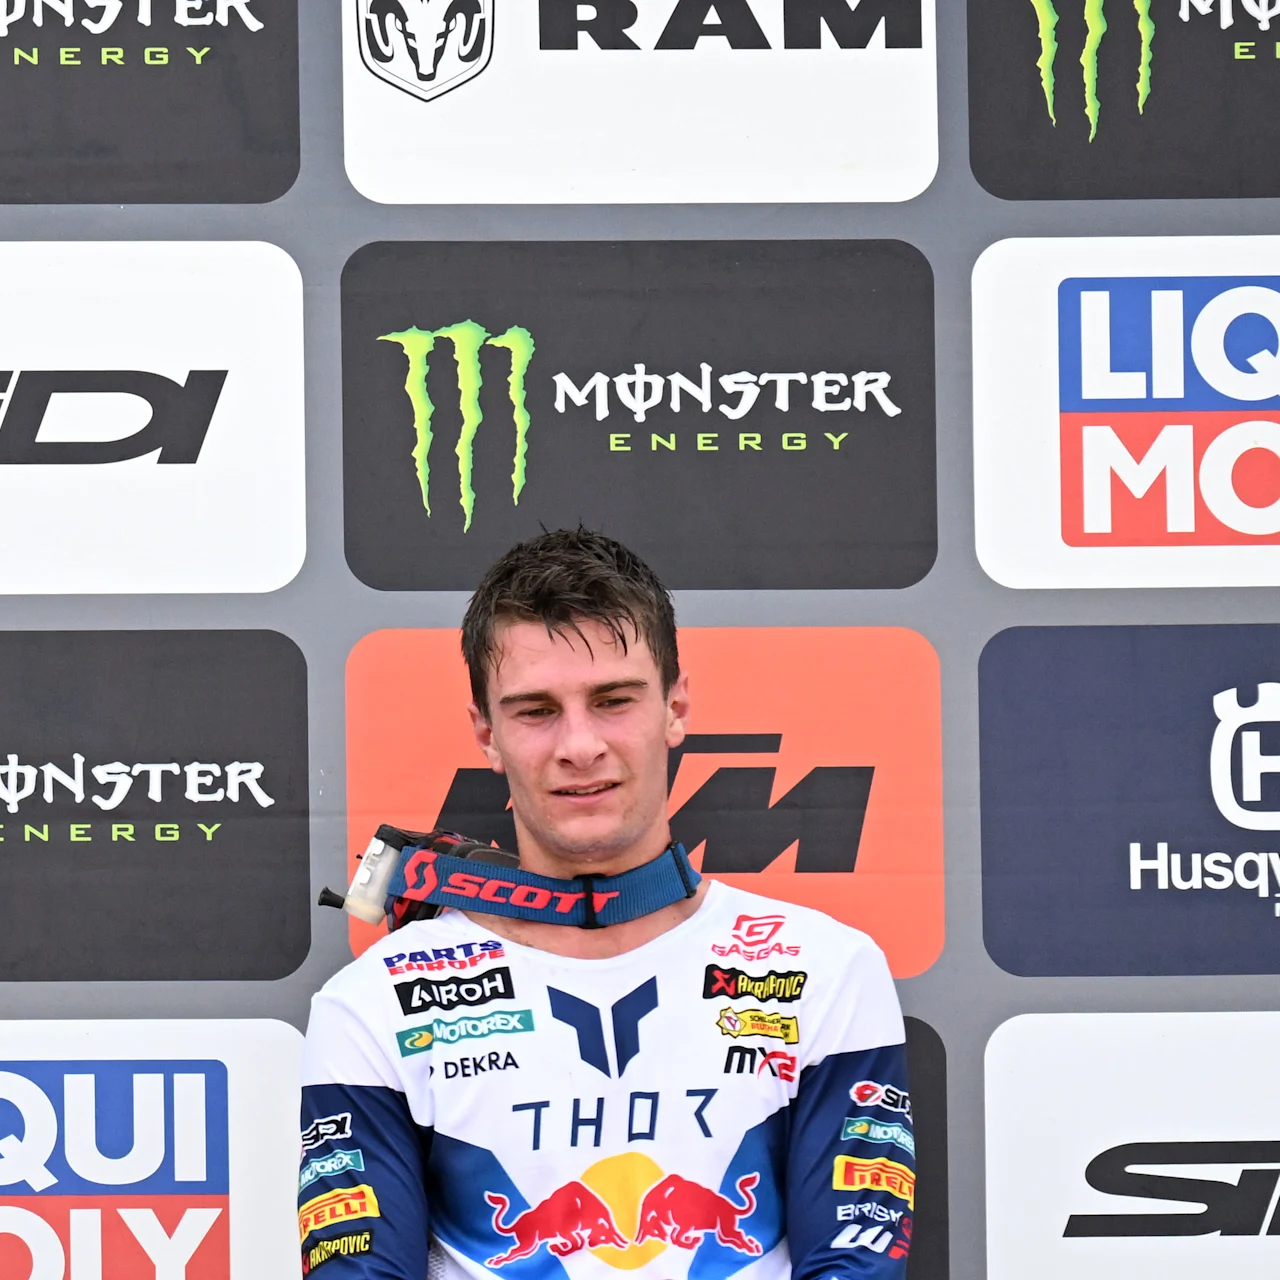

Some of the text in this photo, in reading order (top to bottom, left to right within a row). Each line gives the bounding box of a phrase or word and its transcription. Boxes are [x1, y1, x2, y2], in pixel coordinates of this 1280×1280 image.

[537, 0, 924, 51] RAM
[552, 363, 902, 423] MONSTER
[610, 433, 849, 452] ENERGY
[441, 874, 620, 914] SCOTT
[382, 940, 503, 968] PARTS
[389, 949, 506, 976] EUROPE
[711, 942, 801, 962] GASGAS
[410, 973, 505, 1008] AIROH
[432, 1013, 524, 1042] MOTOREX
[443, 1051, 520, 1080] DEKRA
[724, 1045, 797, 1083] MX2
